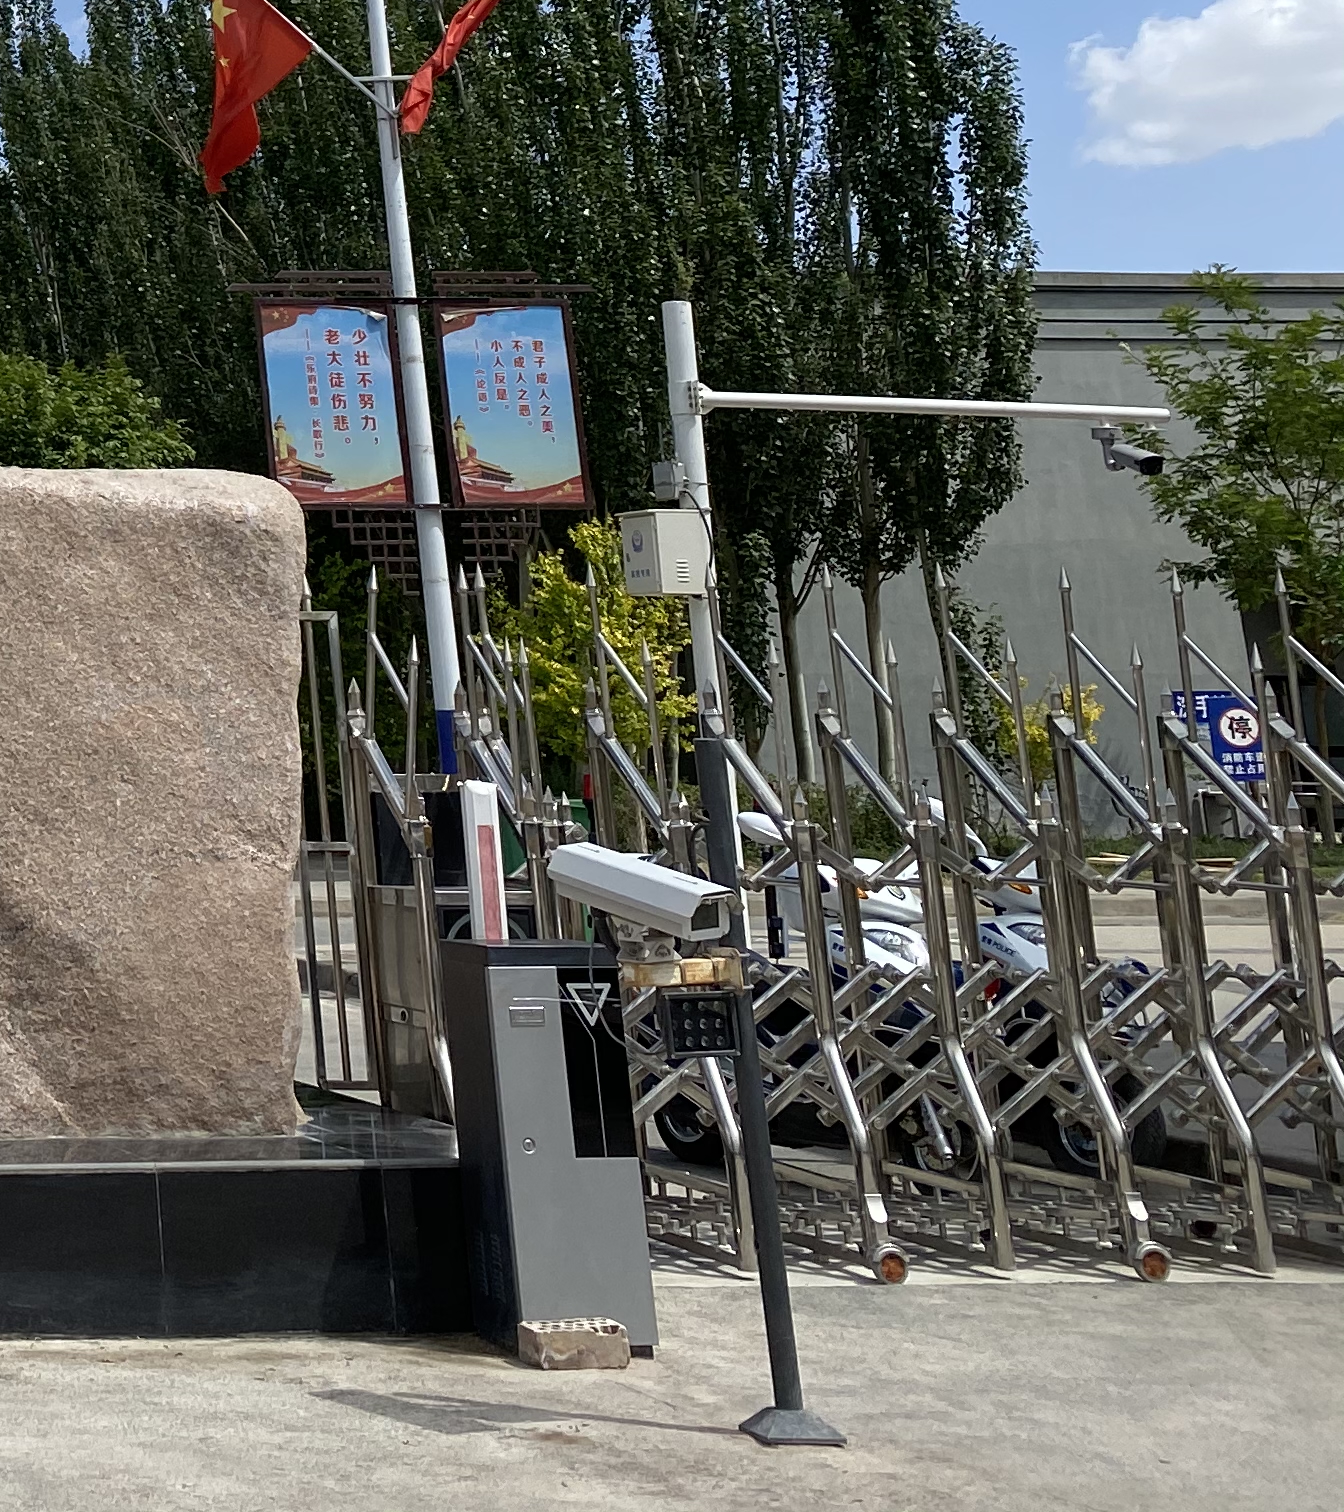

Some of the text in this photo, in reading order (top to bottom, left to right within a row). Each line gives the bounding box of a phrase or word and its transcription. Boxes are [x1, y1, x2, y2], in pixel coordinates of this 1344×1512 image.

[324, 329, 351, 444] 老大徒伤悲。
[352, 329, 379, 445] 少壮不努力，
